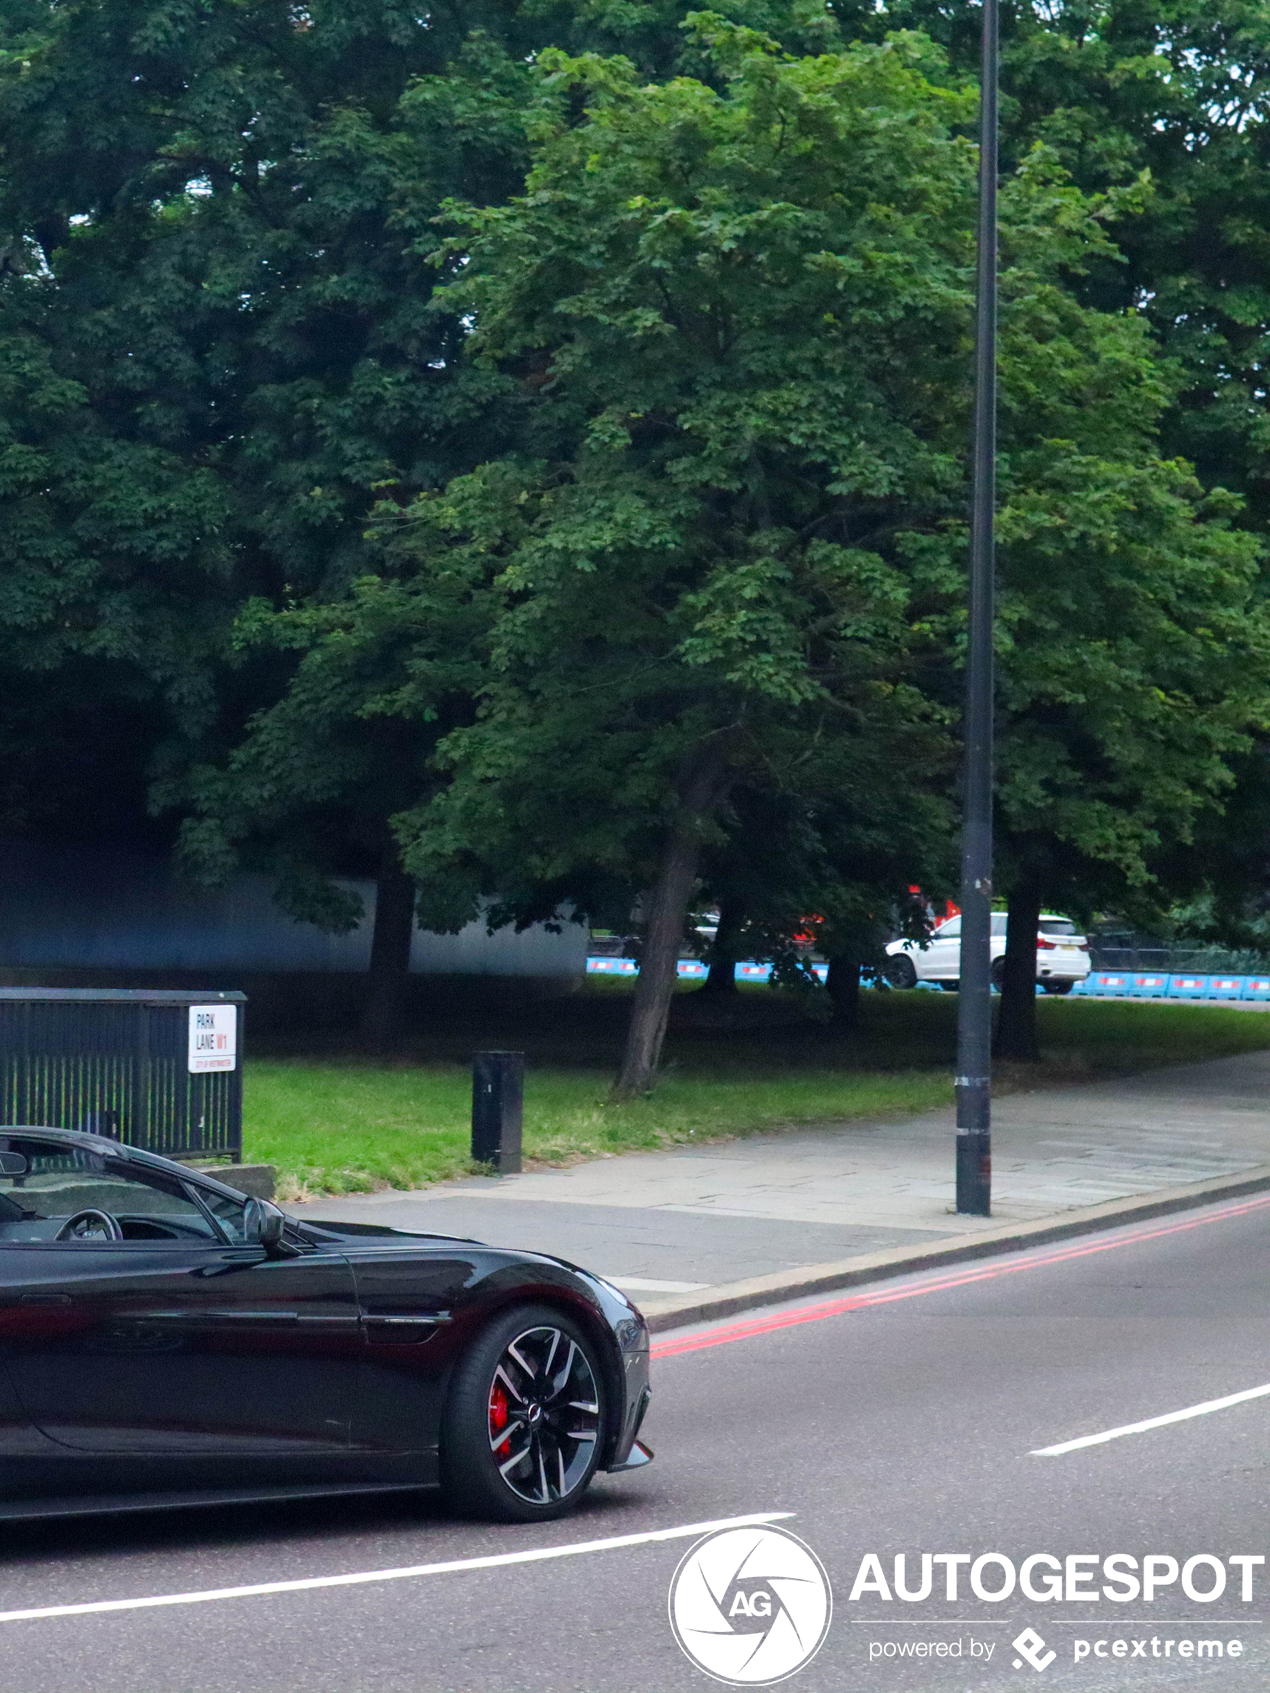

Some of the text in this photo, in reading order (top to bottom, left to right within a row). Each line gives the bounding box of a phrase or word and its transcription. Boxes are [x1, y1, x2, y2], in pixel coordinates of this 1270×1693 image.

[197, 1014, 215, 1029] PARK
[196, 1034, 227, 1050] LANE W1
